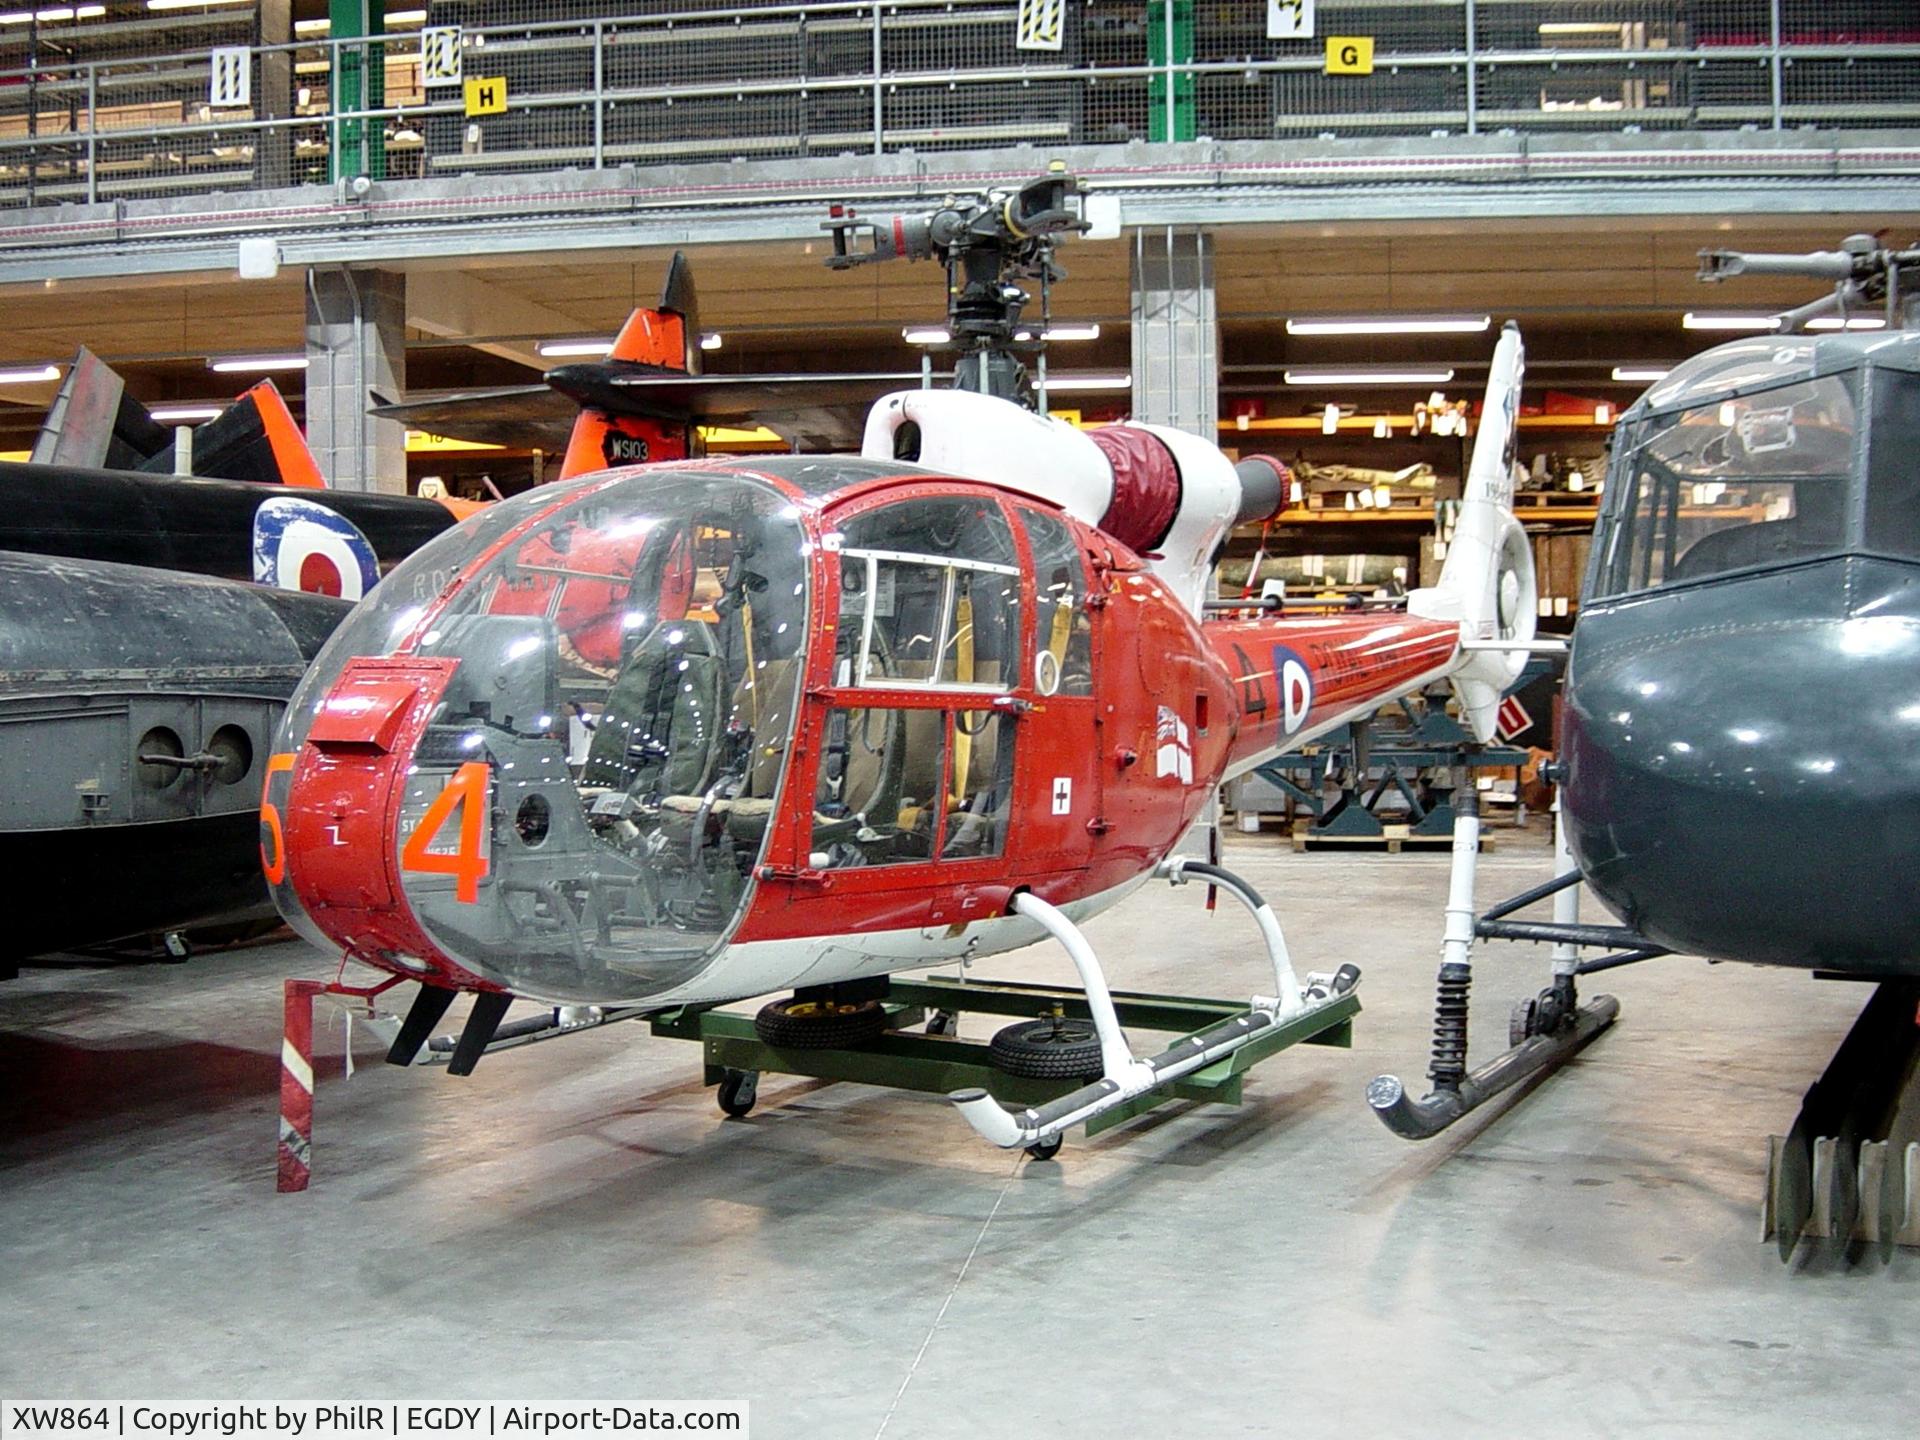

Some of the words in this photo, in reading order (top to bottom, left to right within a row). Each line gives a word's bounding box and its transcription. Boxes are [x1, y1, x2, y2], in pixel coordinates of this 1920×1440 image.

[1341, 46, 1359, 66] G
[479, 86, 495, 108] H
[612, 438, 649, 461] WS103
[402, 761, 491, 905] 4
